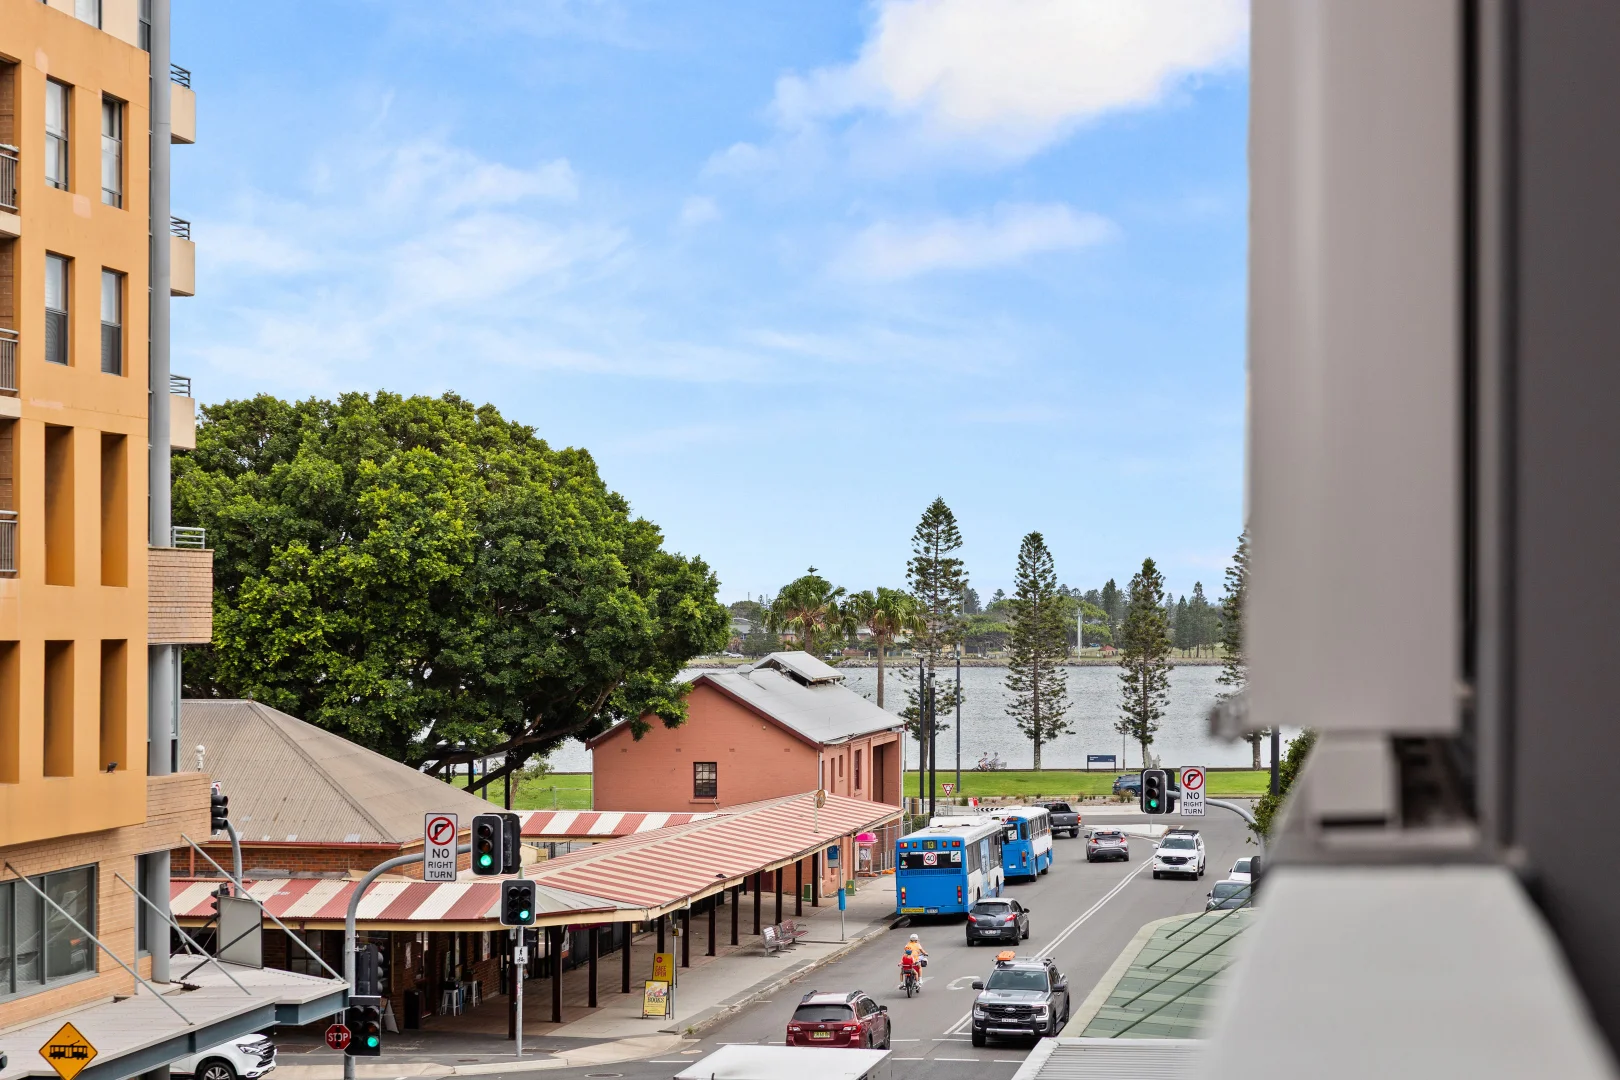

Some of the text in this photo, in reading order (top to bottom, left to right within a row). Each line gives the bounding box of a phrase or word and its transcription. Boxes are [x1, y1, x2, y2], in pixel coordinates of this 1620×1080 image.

[1186, 792, 1200, 800] NO
[927, 841, 934, 849] 13
[432, 848, 450, 859] NO
[428, 861, 453, 869] RIGHT
[429, 870, 453, 879] TURN
[328, 1032, 349, 1042] STOP
